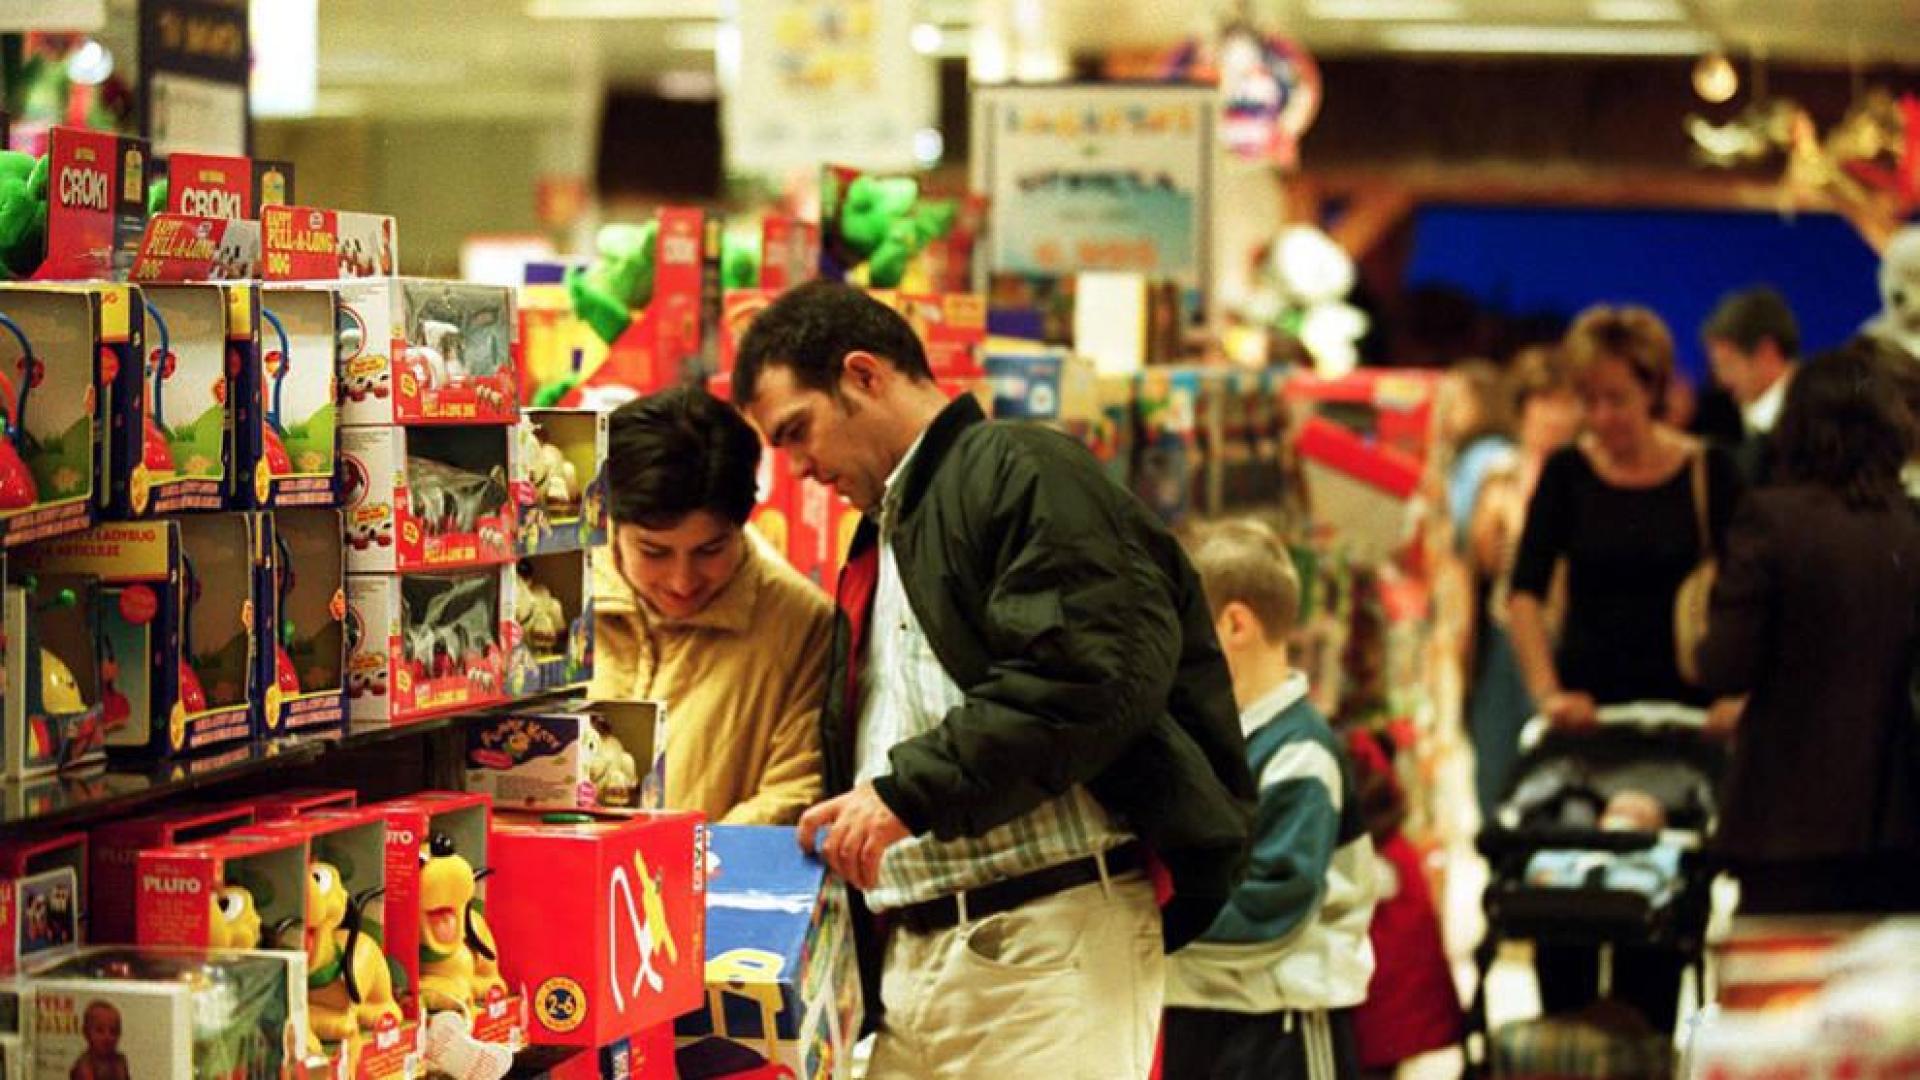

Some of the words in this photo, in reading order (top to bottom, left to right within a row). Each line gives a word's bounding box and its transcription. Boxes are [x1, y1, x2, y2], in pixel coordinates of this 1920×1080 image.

[61, 166, 109, 210] CROKI
[181, 186, 241, 222] CROKI
[143, 875, 202, 894] PLUTO
[548, 993, 574, 1015] 2-6
